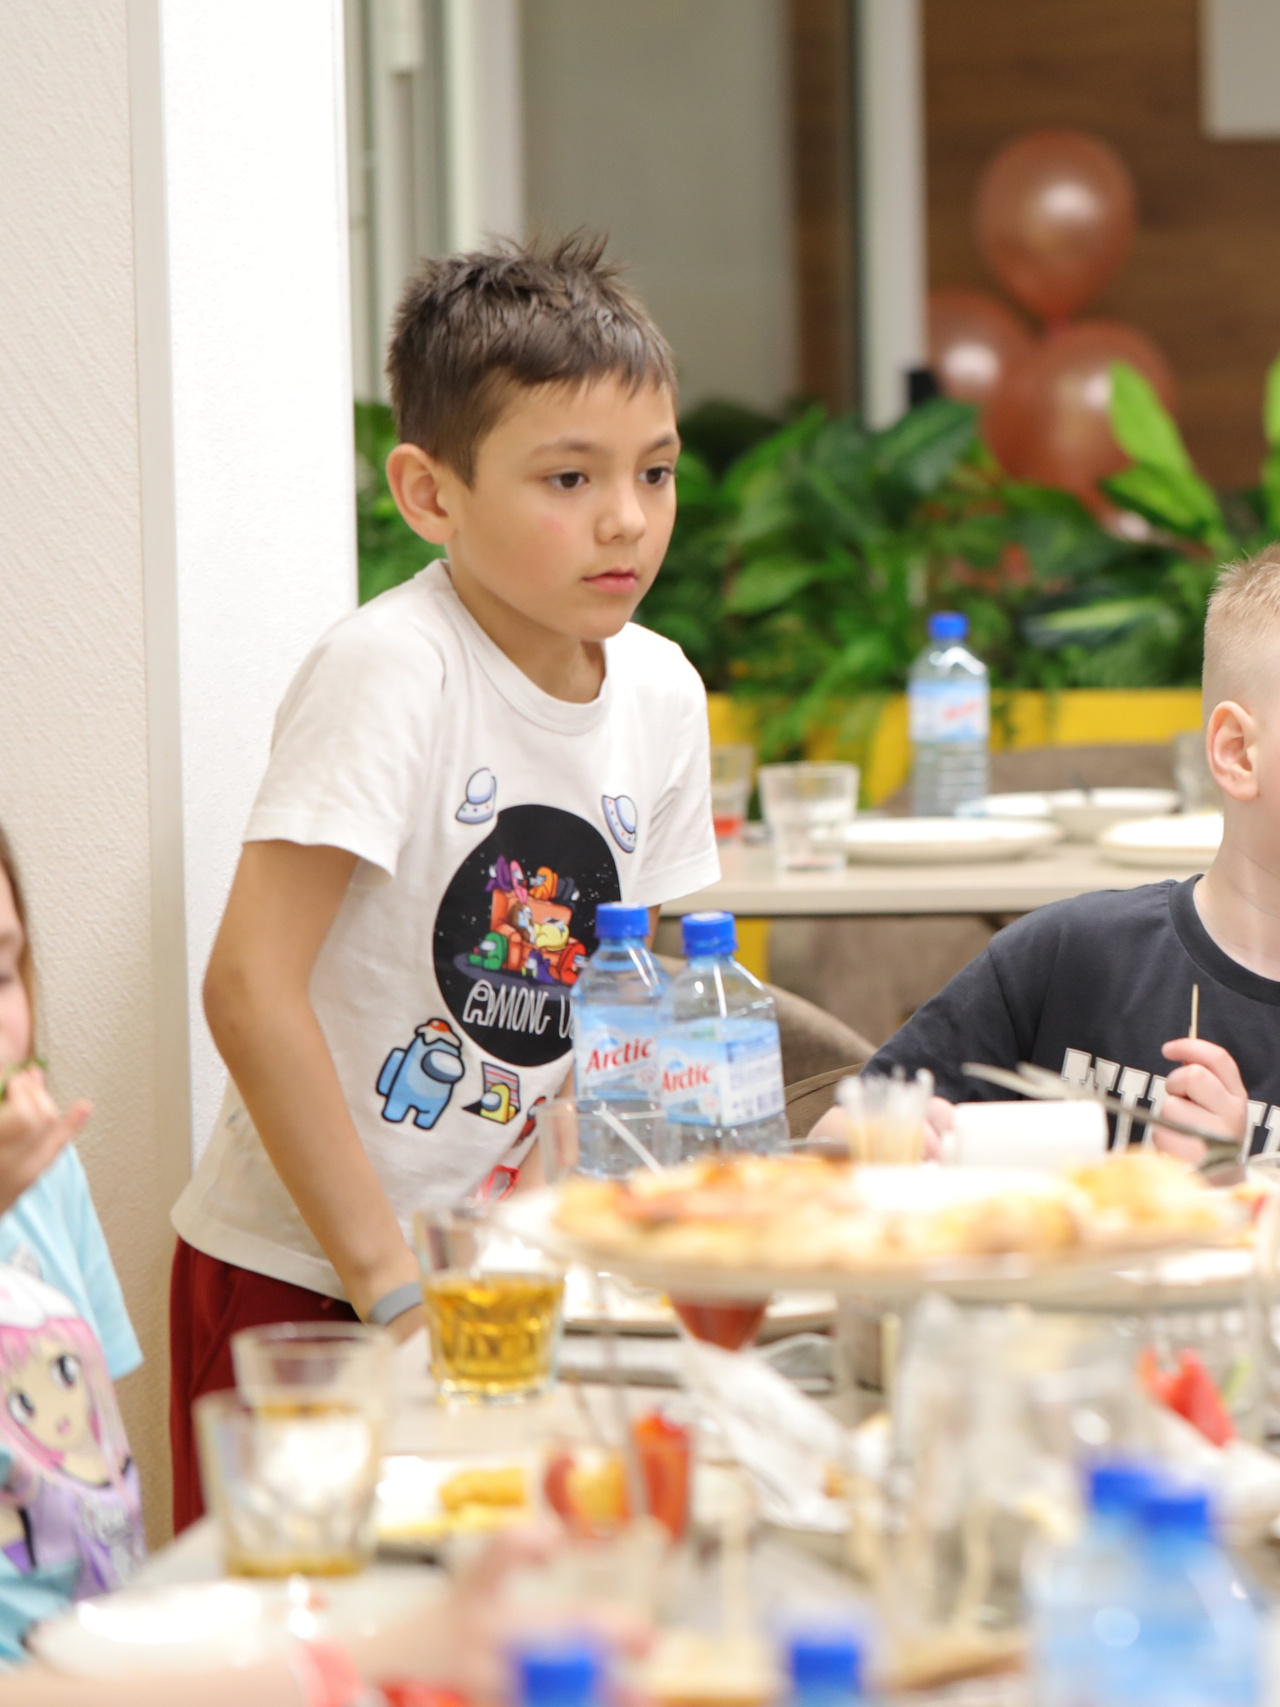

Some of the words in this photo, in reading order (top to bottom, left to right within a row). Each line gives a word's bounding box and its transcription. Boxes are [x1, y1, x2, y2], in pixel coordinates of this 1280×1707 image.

[462, 979, 551, 1035] AMONG
[559, 994, 576, 1039] U
[585, 1035, 656, 1074] Arctic
[661, 1061, 715, 1093] Arctic
